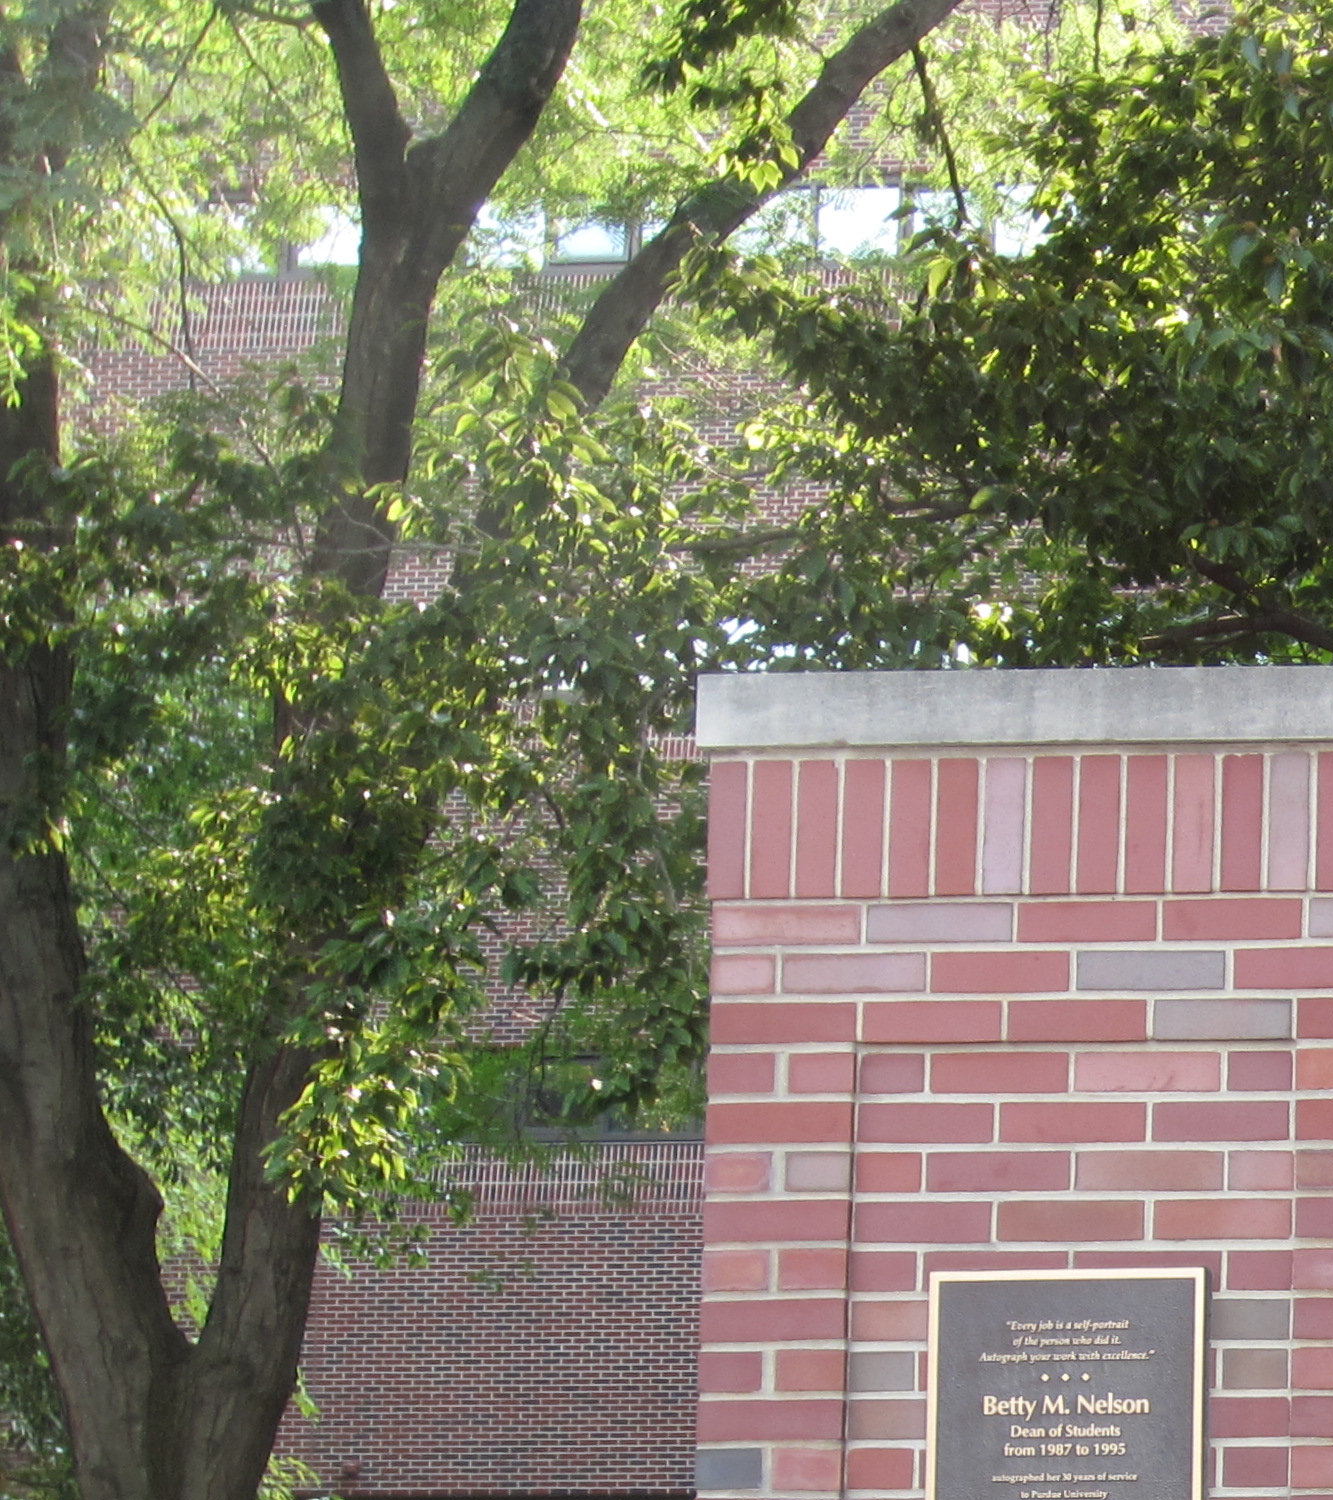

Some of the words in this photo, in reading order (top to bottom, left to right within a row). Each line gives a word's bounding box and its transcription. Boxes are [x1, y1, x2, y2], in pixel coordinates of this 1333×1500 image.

[1038, 1321, 1053, 1332] job
[1056, 1321, 1063, 1330] is
[1074, 1319, 1129, 1332] self-portrait
[1013, 1336, 1022, 1347] of
[1025, 1337, 1038, 1346] the
[1040, 1337, 1070, 1347] person
[1073, 1336, 1092, 1345] who
[1094, 1335, 1109, 1345] did
[1111, 1335, 1121, 1345] it.
[979, 1352, 1027, 1364] Autograph
[1030, 1354, 1050, 1364] your
[1052, 1352, 1077, 1361] work
[1079, 1352, 1100, 1361] with
[983, 1395, 1037, 1421] Betty
[1042, 1395, 1070, 1414] M.
[1077, 1393, 1150, 1414] Nelson
[1010, 1425, 1045, 1438] Dean
[1049, 1424, 1063, 1437] of
[1065, 1423, 1121, 1437] Students
[1004, 1443, 1035, 1456] from
[1040, 1444, 1071, 1456] 1987
[1076, 1444, 1089, 1456] to
[1094, 1443, 1126, 1455] 1995
[991, 1473, 1045, 1484] autographed
[1046, 1473, 1060, 1481] her
[1073, 1474, 1095, 1483] years
[1098, 1472, 1106, 1481] of
[1108, 1472, 1137, 1481] service
[1021, 1491, 1030, 1499] to
[1031, 1491, 1061, 1499] Purdue
[1063, 1490, 1109, 1500] University
